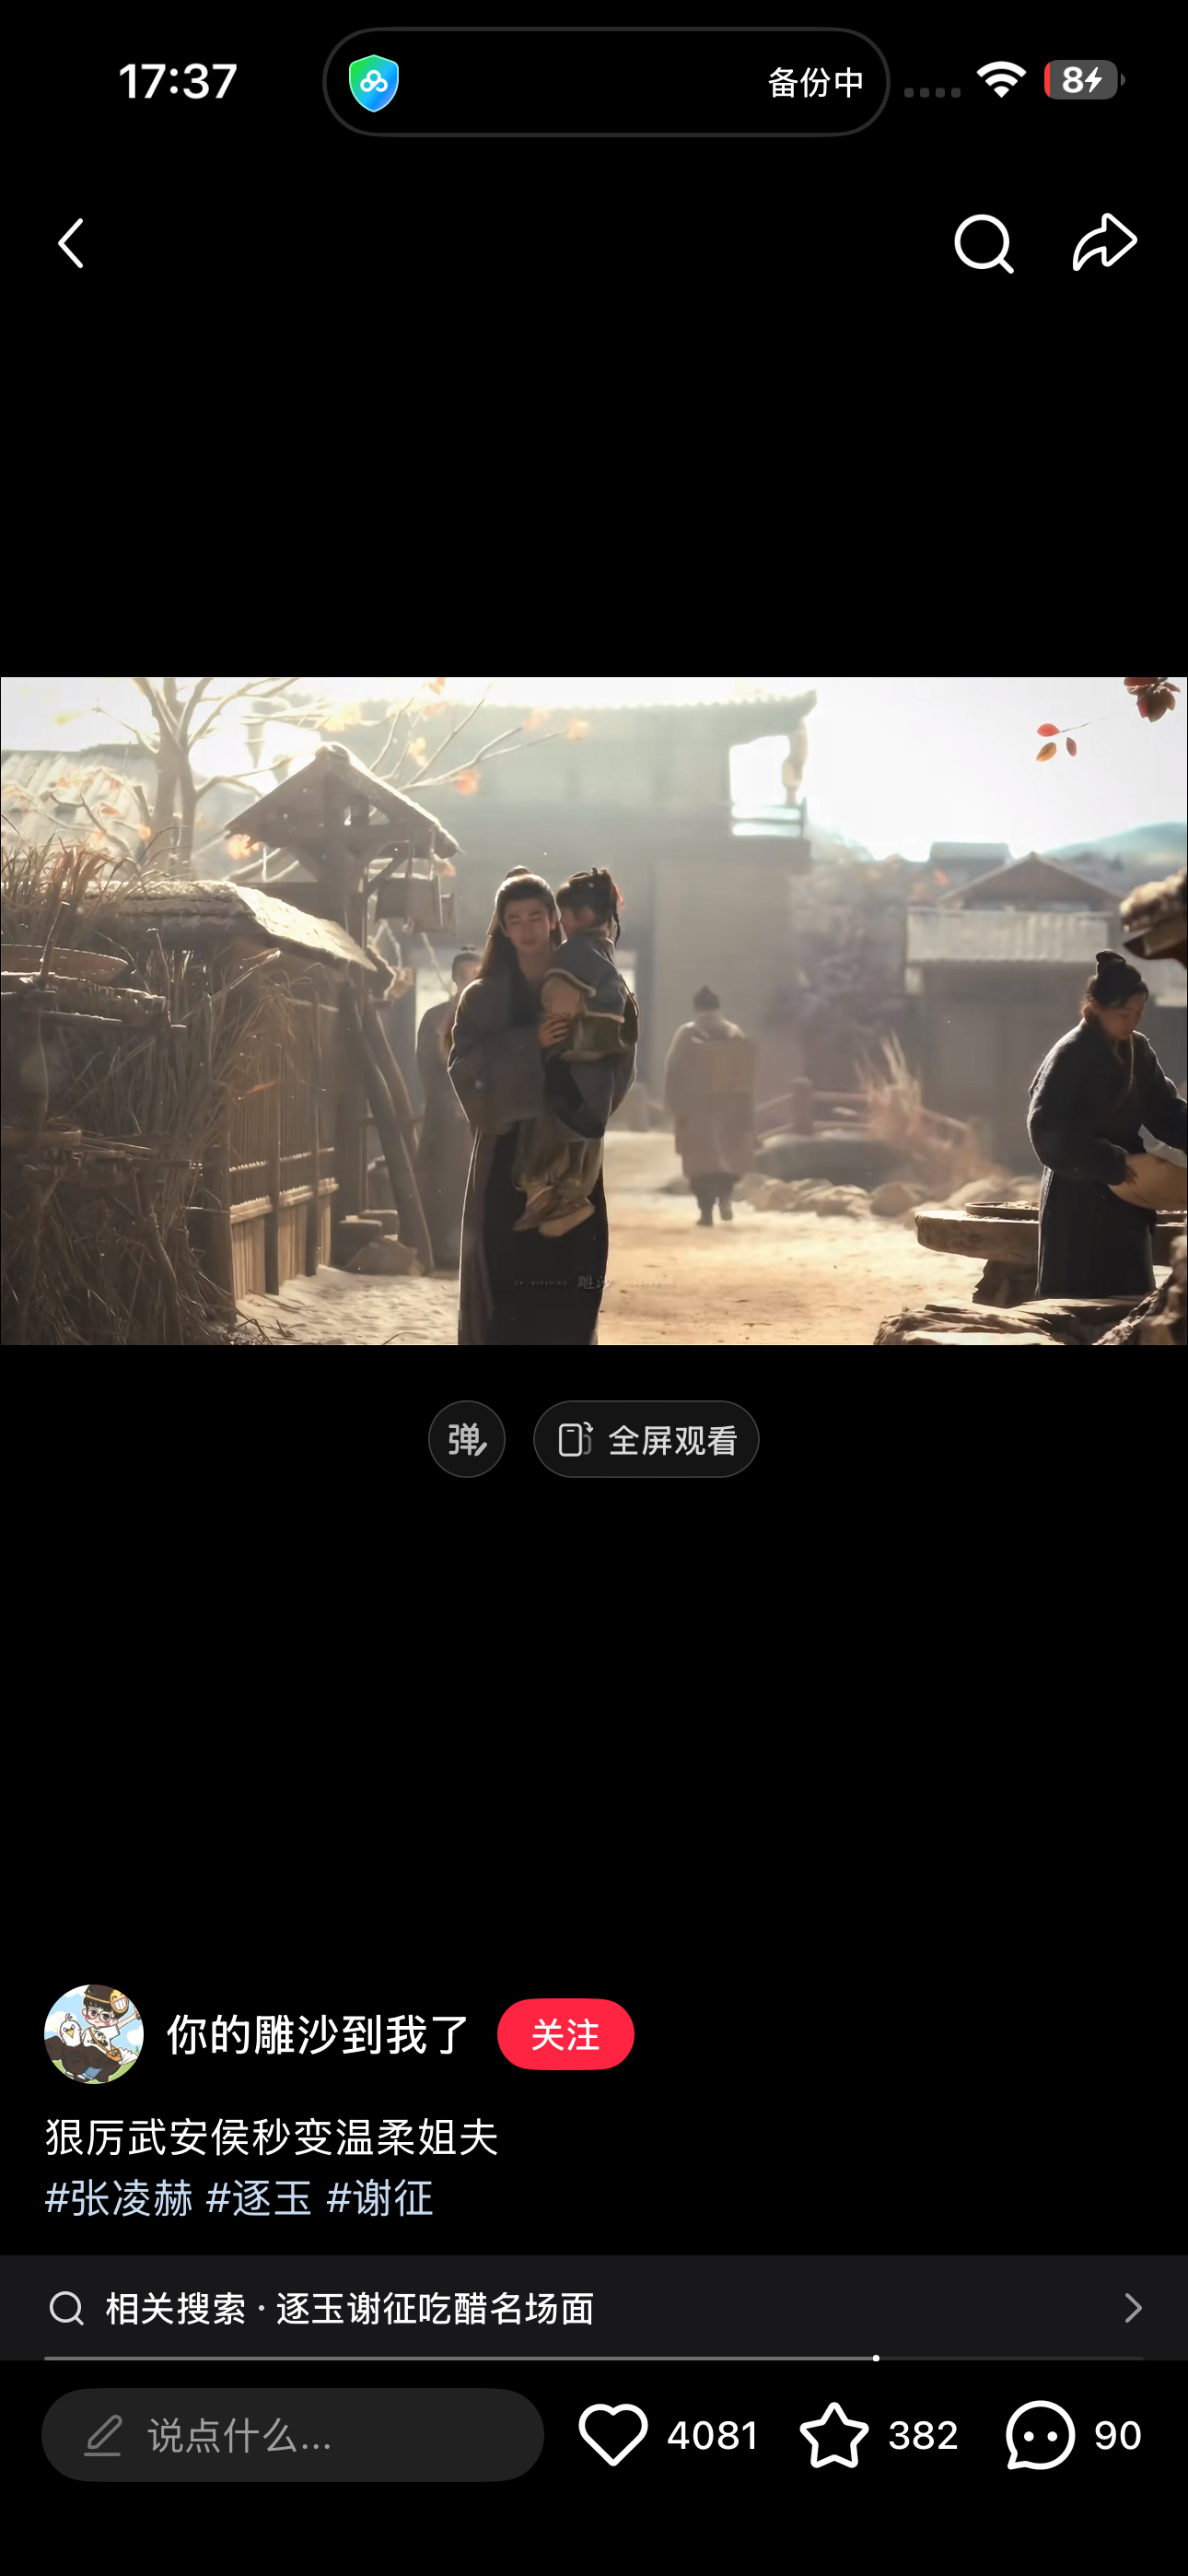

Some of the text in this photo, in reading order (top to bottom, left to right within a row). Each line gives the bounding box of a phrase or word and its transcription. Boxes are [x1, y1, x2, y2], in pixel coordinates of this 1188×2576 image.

[120, 63, 237, 100] 17:37
[768, 67, 862, 98] 备份中
[1062, 65, 1084, 94] 8
[448, 1423, 481, 1457] 弹
[609, 1424, 738, 1457] 全屏观看
[167, 2014, 467, 2055] 你的雕沙到我了
[531, 2019, 600, 2051] 关注
[46, 2117, 498, 2156] 狠厉武安侯秒变温柔姐夫
[44, 2179, 433, 2218] #张凌赫 #逐玉 #谢征
[105, 2291, 246, 2324] 相关搜索
[277, 2291, 594, 2324] 逐玉谢征吃醋名场面
[668, 2420, 755, 2451] 4081
[890, 2420, 958, 2451] 382
[1094, 2420, 1142, 2451] 90
